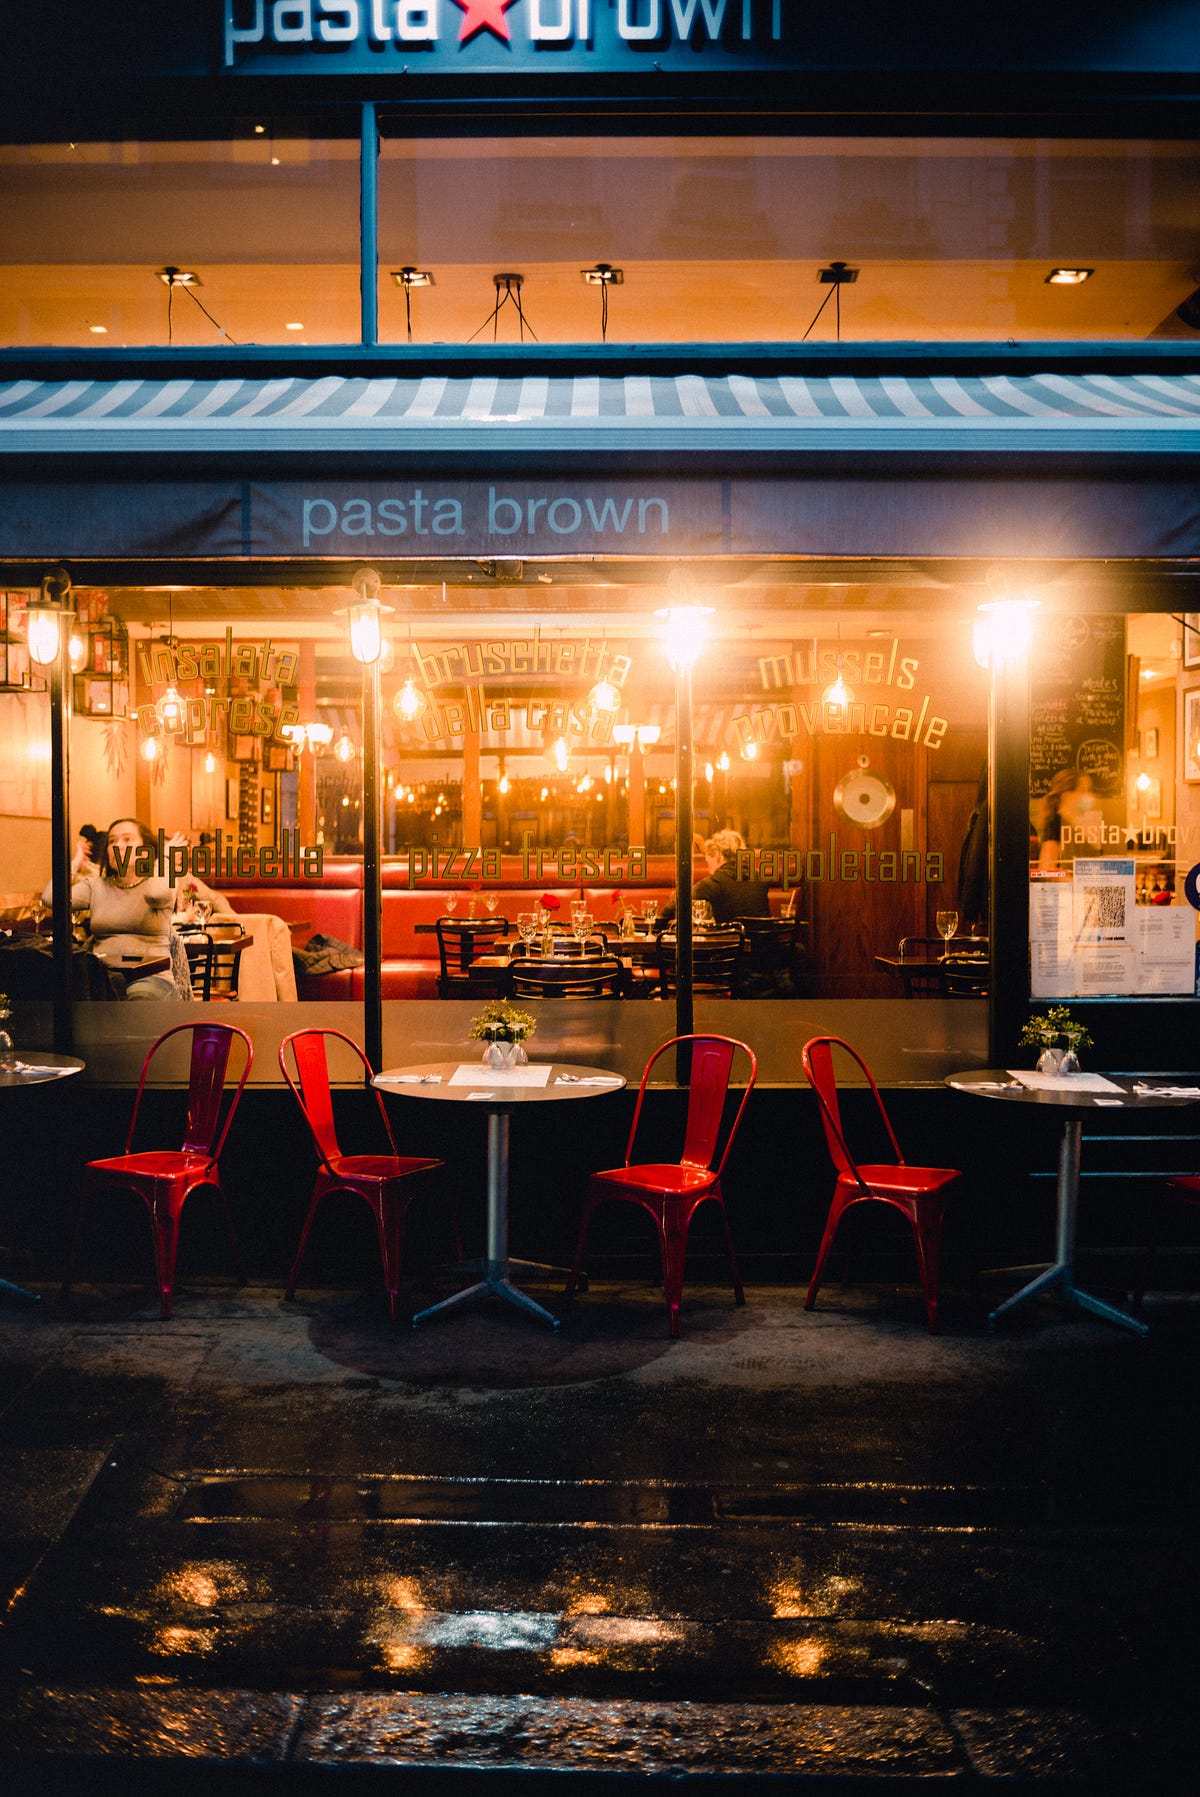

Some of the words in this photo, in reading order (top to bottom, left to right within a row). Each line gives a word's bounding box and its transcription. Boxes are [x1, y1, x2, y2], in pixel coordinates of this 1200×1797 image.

[302, 489, 465, 547] pasta
[488, 486, 669, 535] brown
[138, 626, 298, 687] insalata
[411, 623, 632, 689] bruschetta
[758, 638, 919, 690] mussels
[137, 697, 300, 745] caprese
[421, 683, 511, 744] della
[525, 699, 618, 743] casa
[731, 695, 949, 760] provencale
[113, 828, 324, 888] valpolicella
[408, 834, 502, 890] pizza
[520, 829, 648, 881] fresca
[736, 831, 945, 891] napoletana
[1060, 820, 1120, 850] pasta
